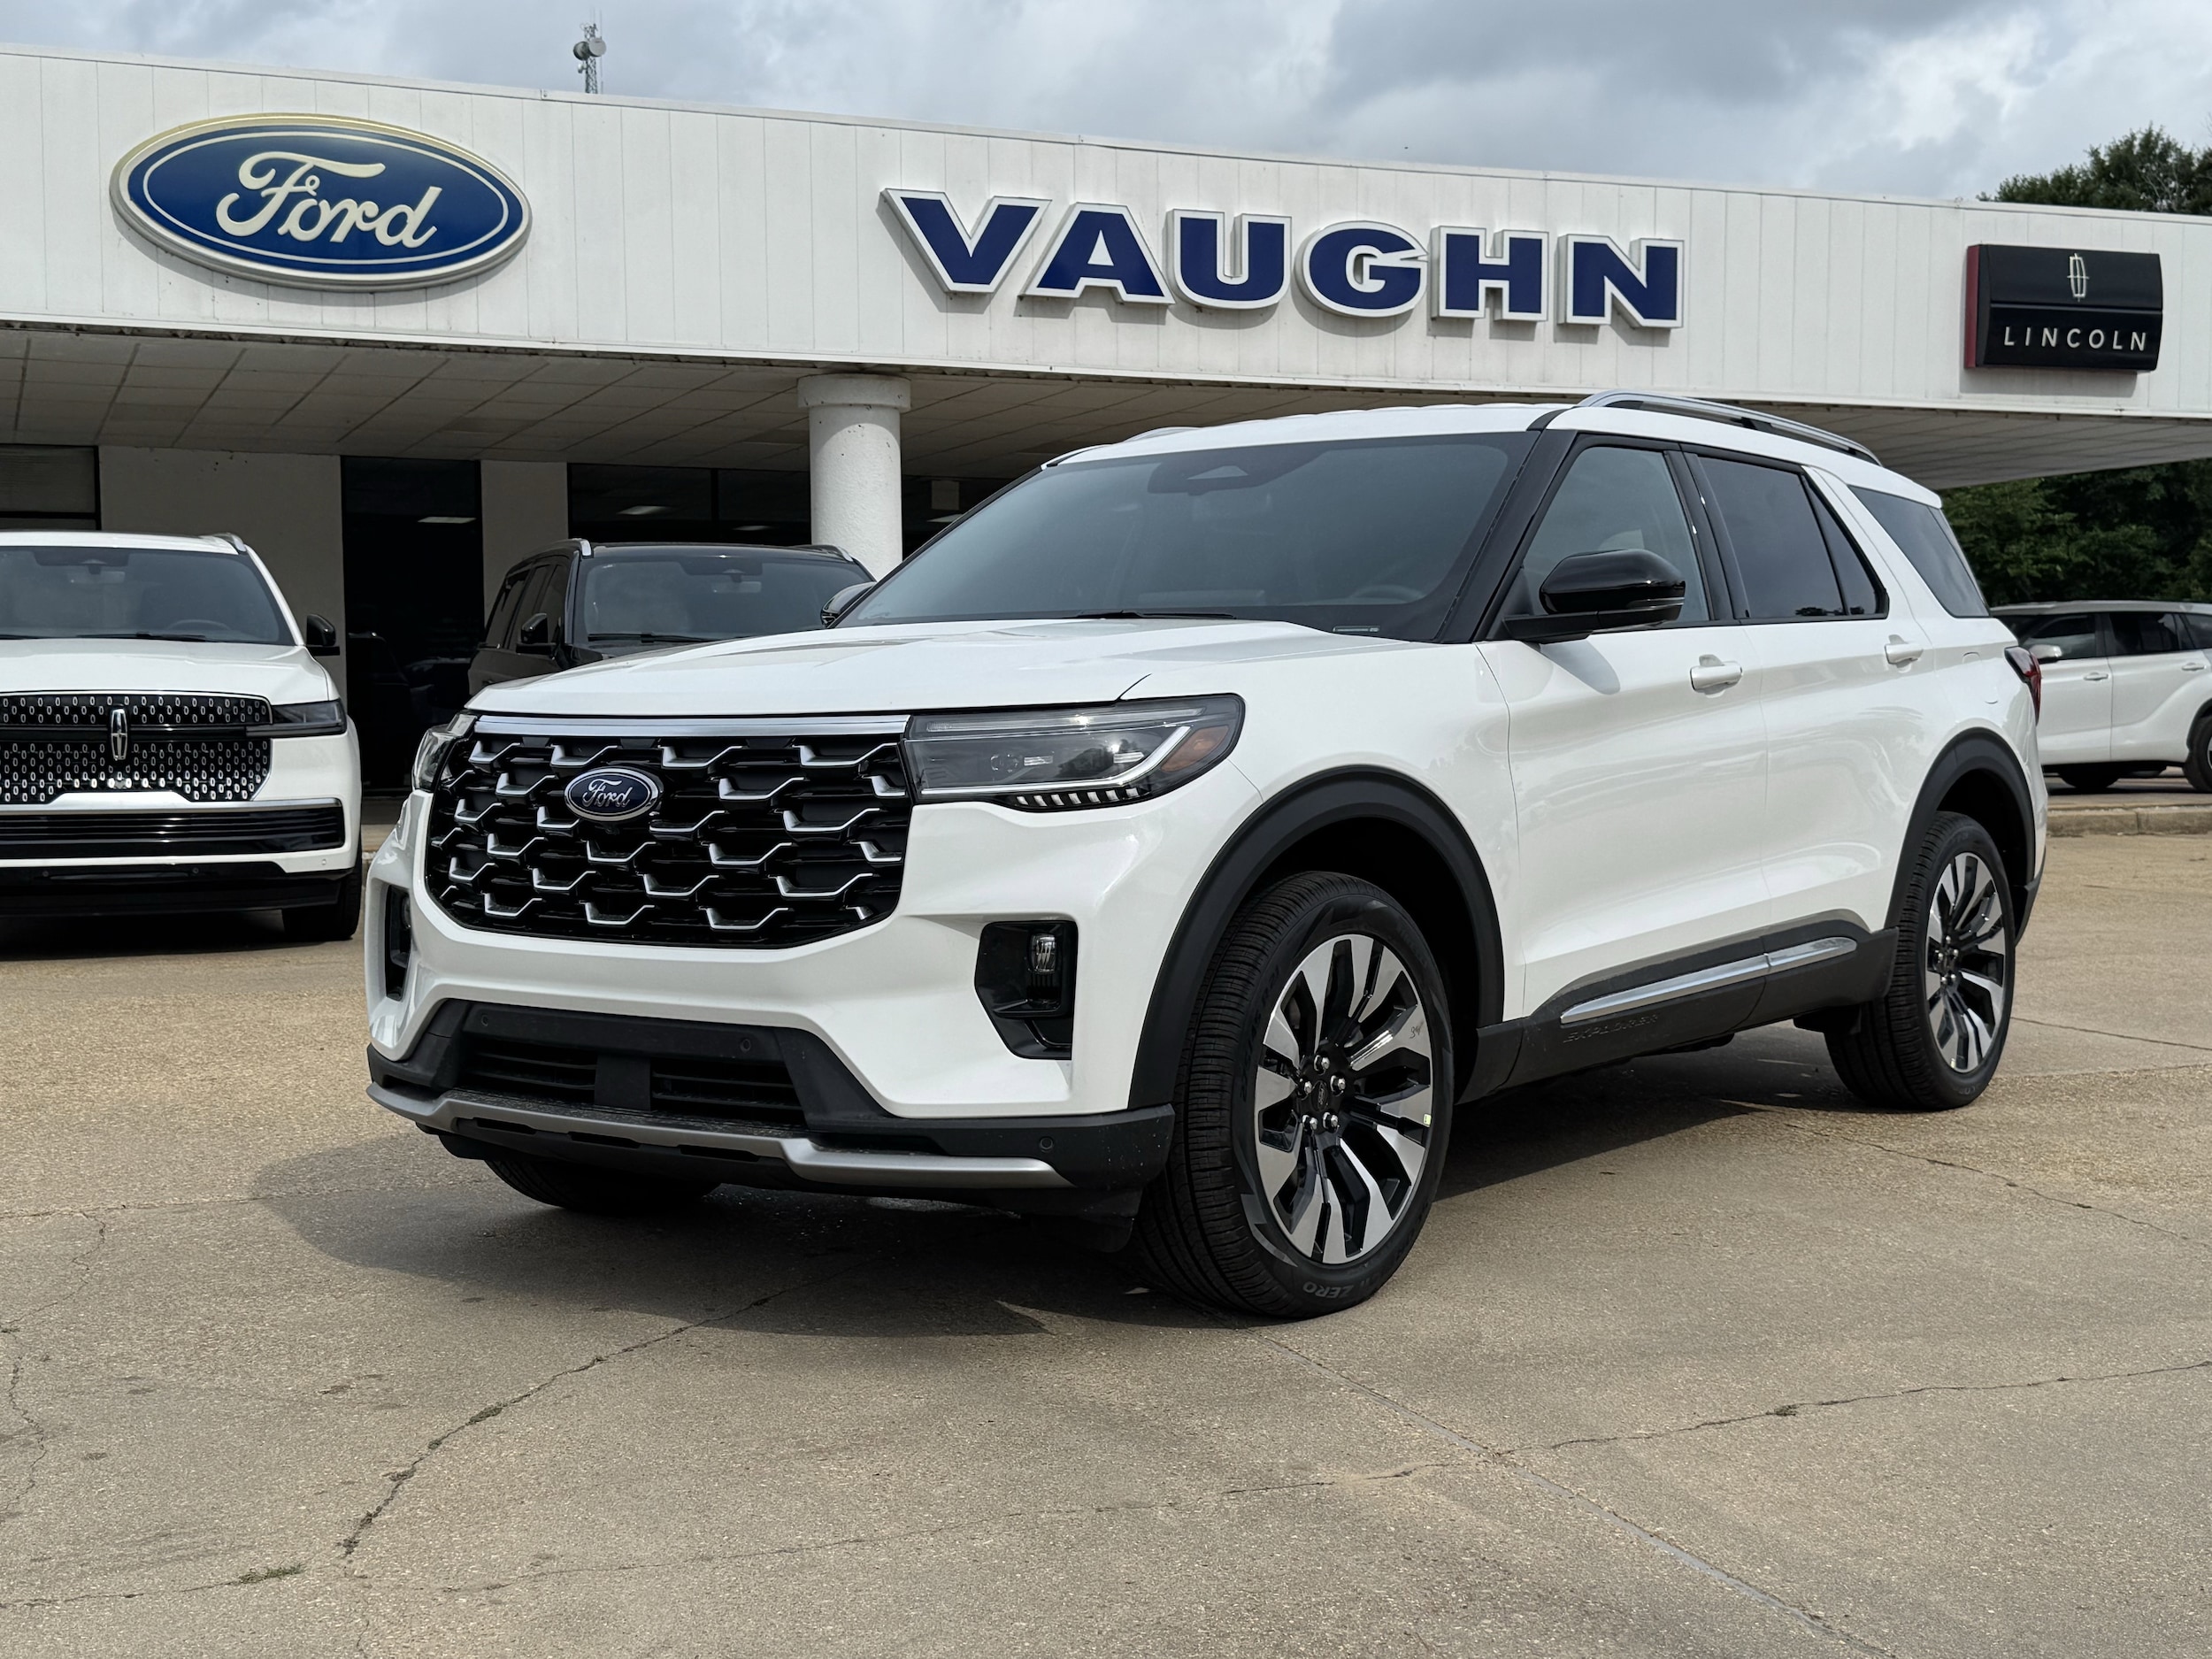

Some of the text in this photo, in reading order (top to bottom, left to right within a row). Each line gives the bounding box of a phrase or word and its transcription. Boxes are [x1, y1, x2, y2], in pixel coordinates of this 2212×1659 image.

[216, 151, 442, 249] Ford
[882, 188, 1685, 328] VAUGHN
[2003, 326, 2147, 352] LINCOLN
[582, 779, 634, 807] Ford
[1302, 1280, 1355, 1299] ZERO
